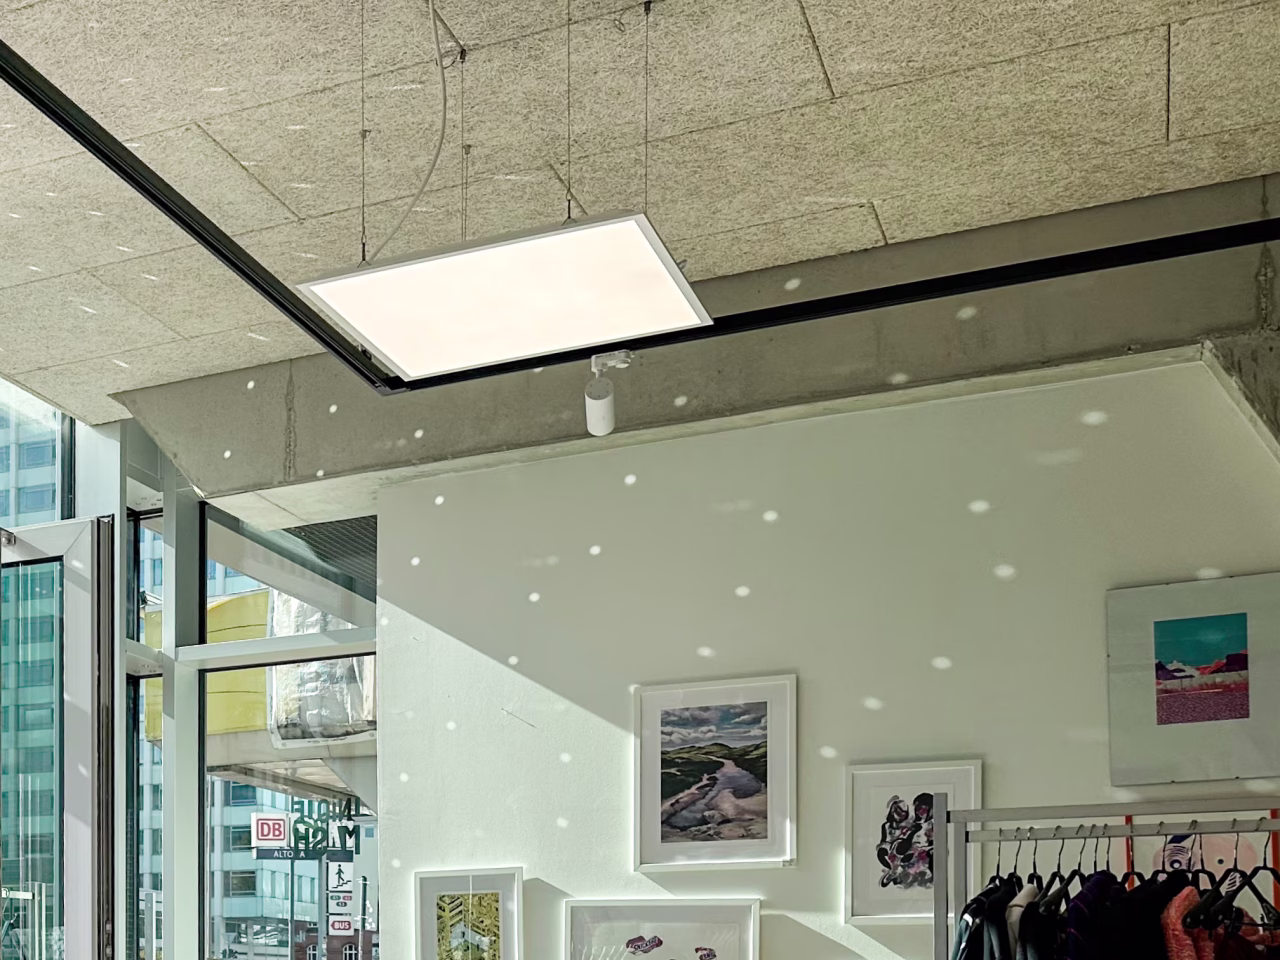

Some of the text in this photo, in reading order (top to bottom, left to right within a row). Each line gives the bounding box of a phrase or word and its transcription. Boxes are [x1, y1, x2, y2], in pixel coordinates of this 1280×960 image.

[260, 822, 283, 838] DB
[273, 850, 306, 858] ALTOA
[334, 921, 351, 930] BUS
